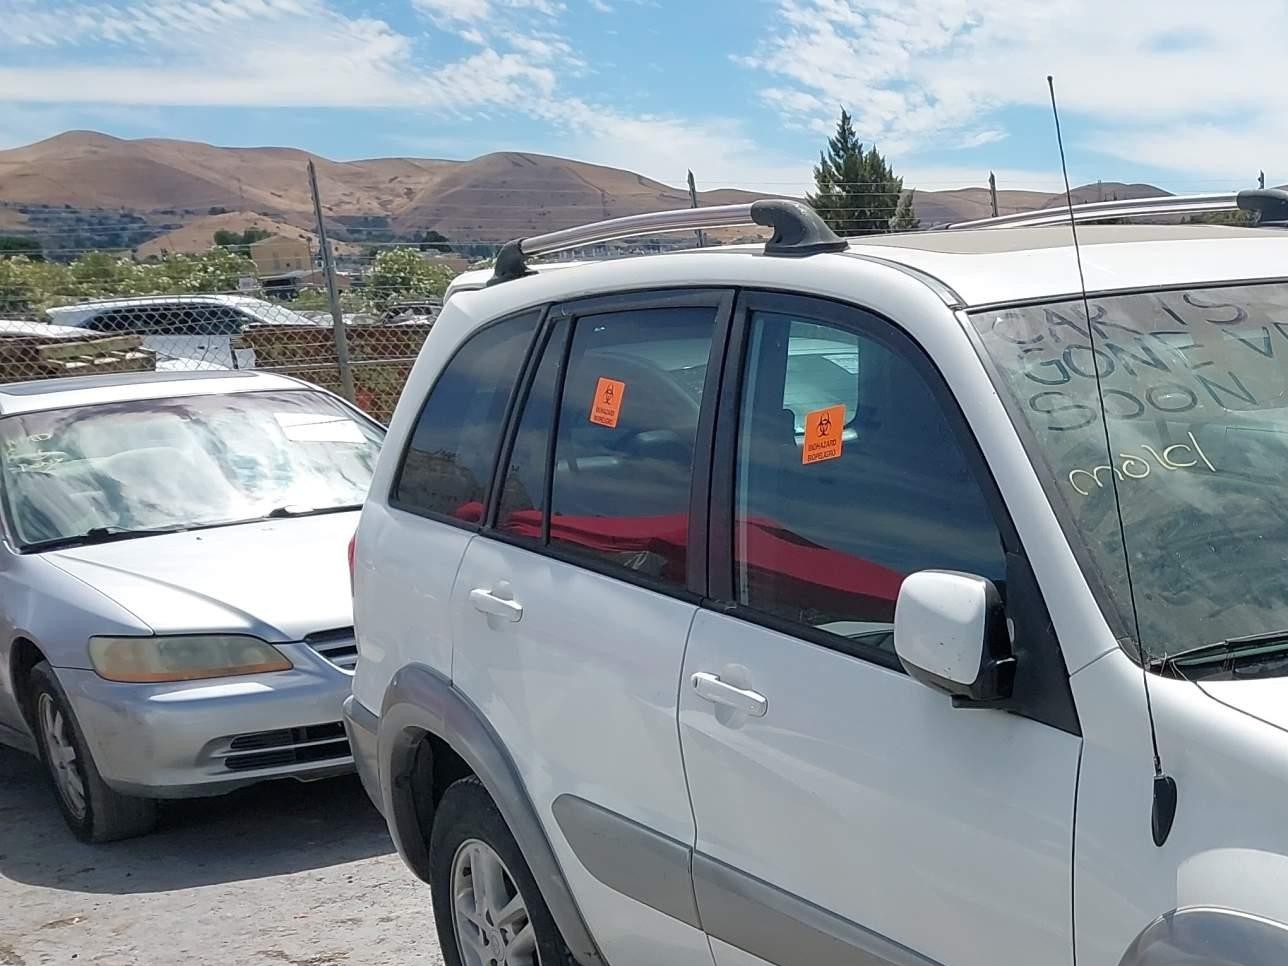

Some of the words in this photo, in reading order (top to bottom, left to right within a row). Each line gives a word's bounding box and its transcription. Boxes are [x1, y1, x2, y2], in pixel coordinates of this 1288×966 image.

[1161, 293, 1249, 326] IS
[1018, 330, 1214, 386] GONE
[1028, 370, 1260, 432] SOON
